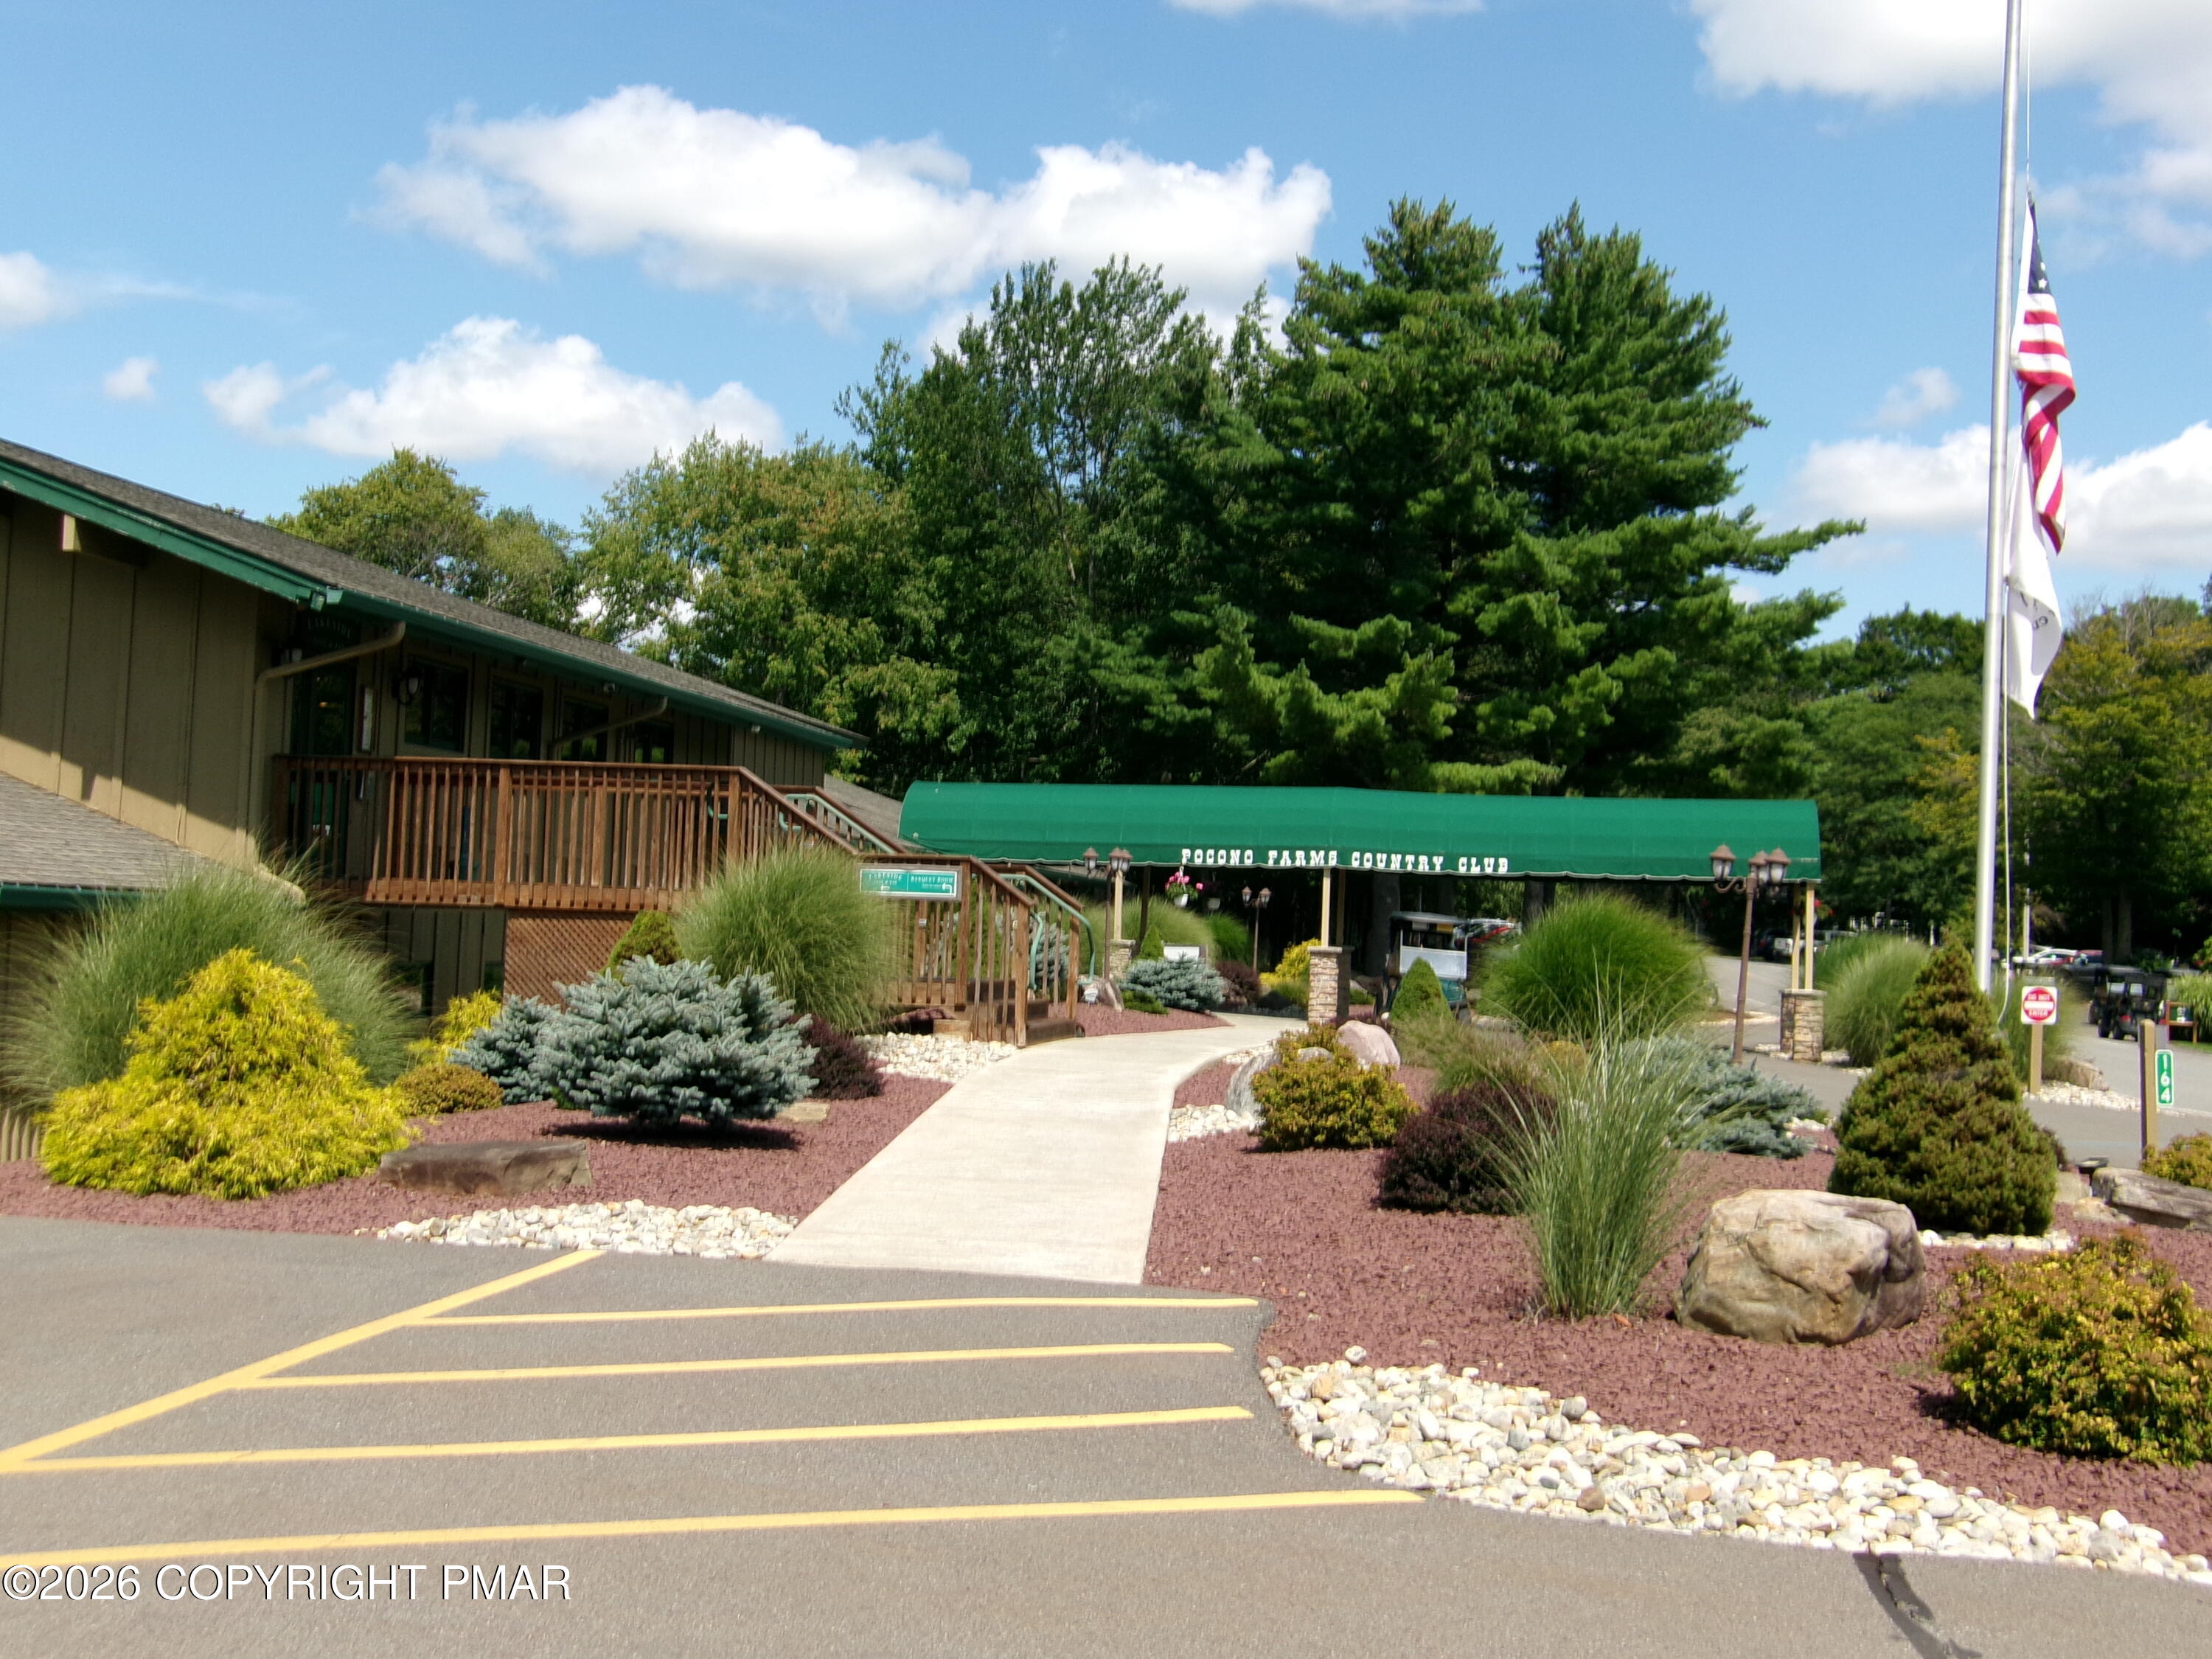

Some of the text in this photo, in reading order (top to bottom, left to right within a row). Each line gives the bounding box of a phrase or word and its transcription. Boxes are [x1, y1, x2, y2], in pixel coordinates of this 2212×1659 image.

[1181, 849, 1509, 873] POCONO FARMS COUNTRY CLUB
[2028, 993, 2050, 1002] DO NOT
[2028, 1009, 2048, 1018] ENTER
[2160, 1054, 2171, 1103] 164
